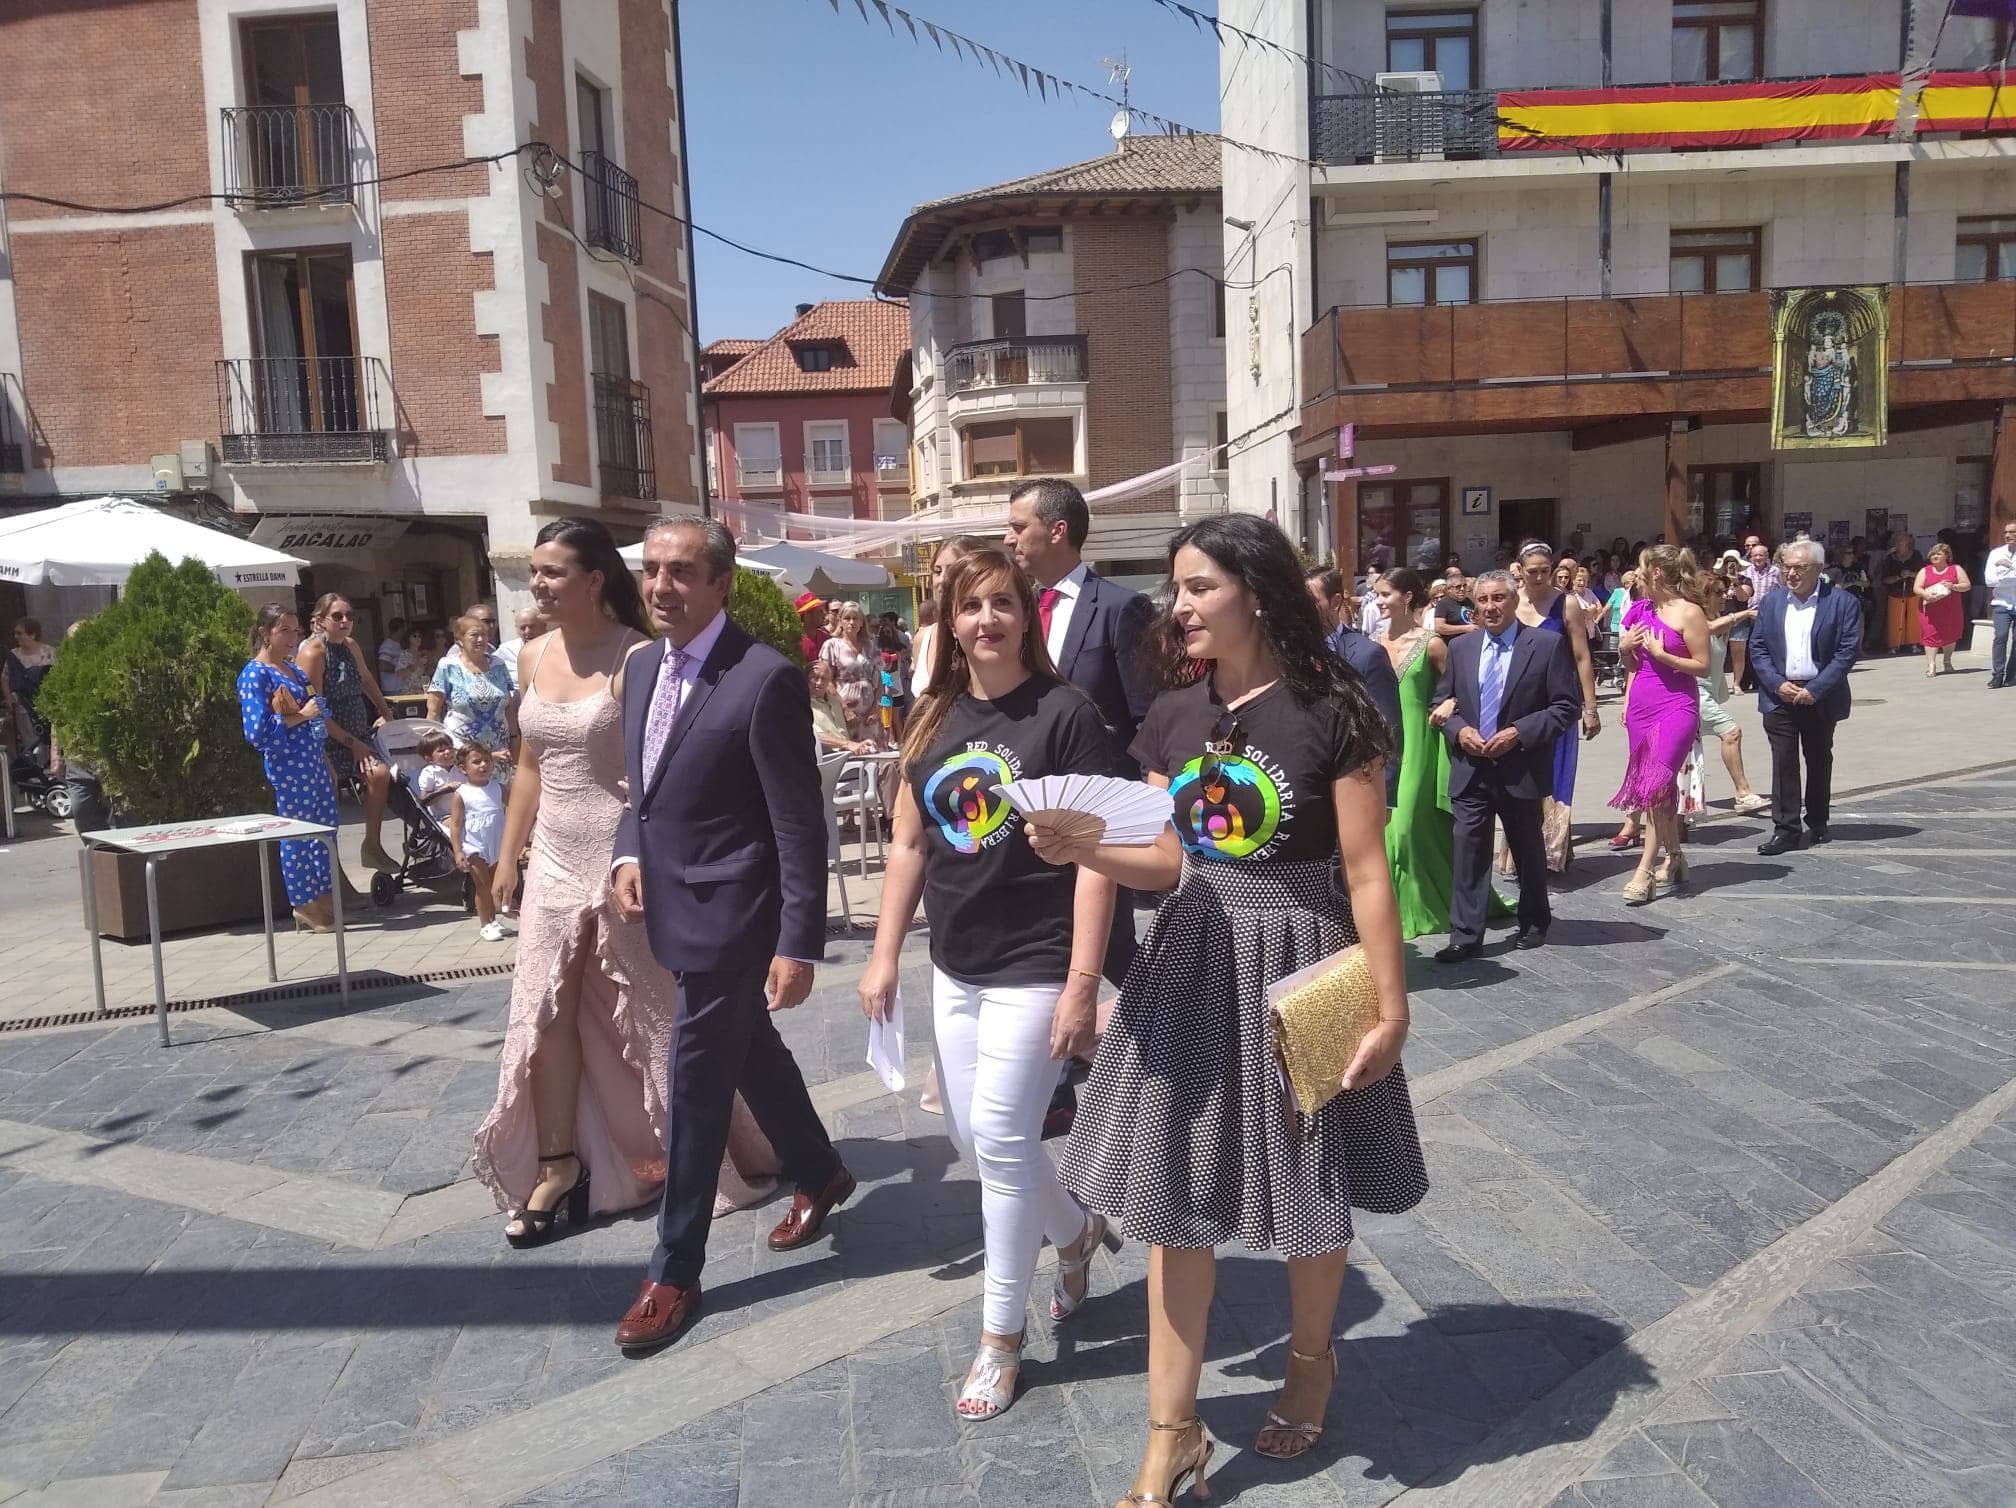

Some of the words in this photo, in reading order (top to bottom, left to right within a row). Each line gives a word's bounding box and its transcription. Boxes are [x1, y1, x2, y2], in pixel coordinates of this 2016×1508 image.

[280, 532, 372, 548] BACALAO
[0, 565, 19, 577] AMM
[243, 573, 269, 582] ESTRELLA
[270, 573, 286, 581] DAMM
[966, 741, 988, 752] RED
[1205, 741, 1232, 754] RED
